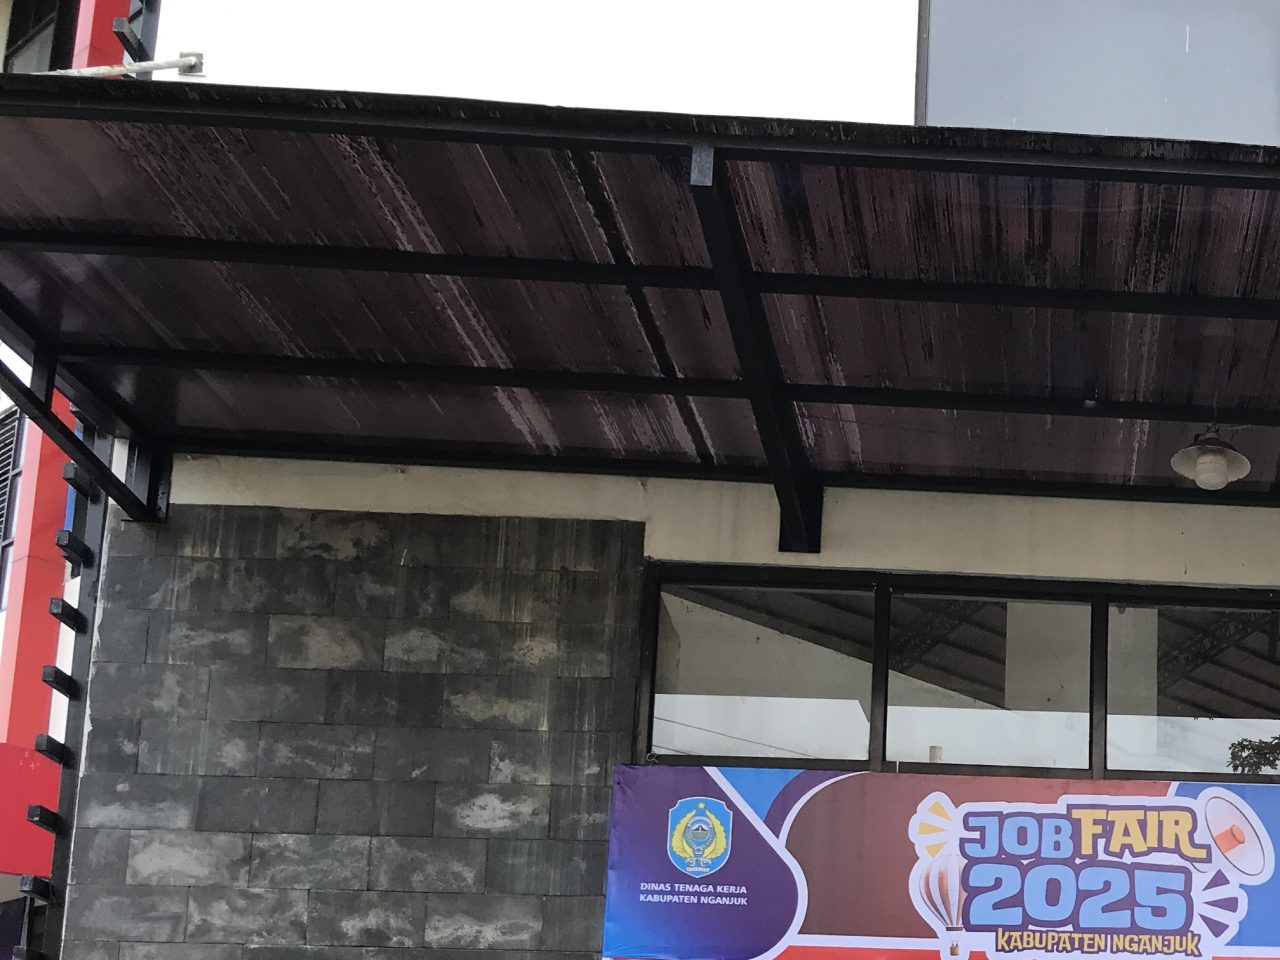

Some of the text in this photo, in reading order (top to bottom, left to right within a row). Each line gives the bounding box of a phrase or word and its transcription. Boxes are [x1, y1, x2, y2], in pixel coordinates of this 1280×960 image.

[964, 808, 1207, 859] JOB FAIR
[639, 894, 748, 905] KABUPATEN NGANJUK
[640, 882, 747, 894] DINAS TENAGA KERJA
[968, 863, 1187, 931] 2025
